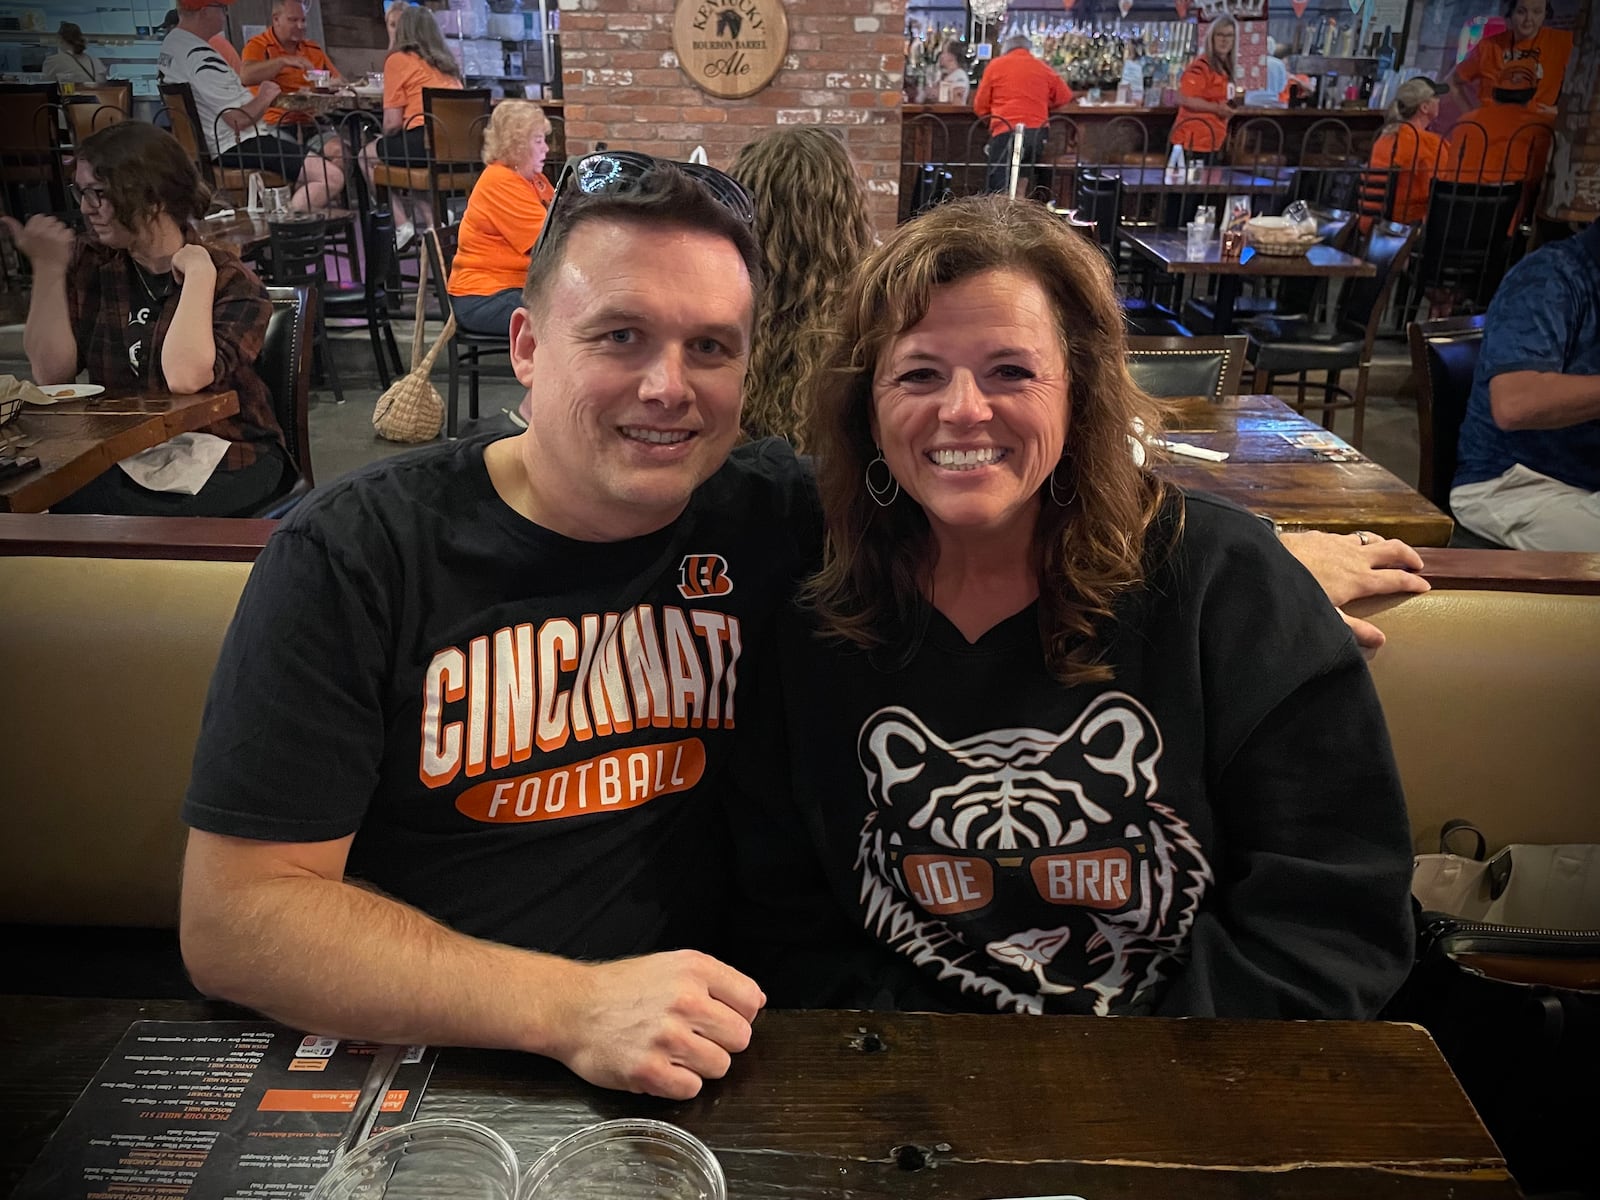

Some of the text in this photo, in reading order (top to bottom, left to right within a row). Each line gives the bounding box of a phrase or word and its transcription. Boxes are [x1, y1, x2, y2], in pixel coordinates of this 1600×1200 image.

[693, 41, 767, 50] BOURBON BARREL
[703, 50, 751, 78] Ale
[420, 604, 742, 788] CINCINNATI
[488, 746, 684, 818] FOOTBALL
[914, 859, 1127, 905] JOE BRR
